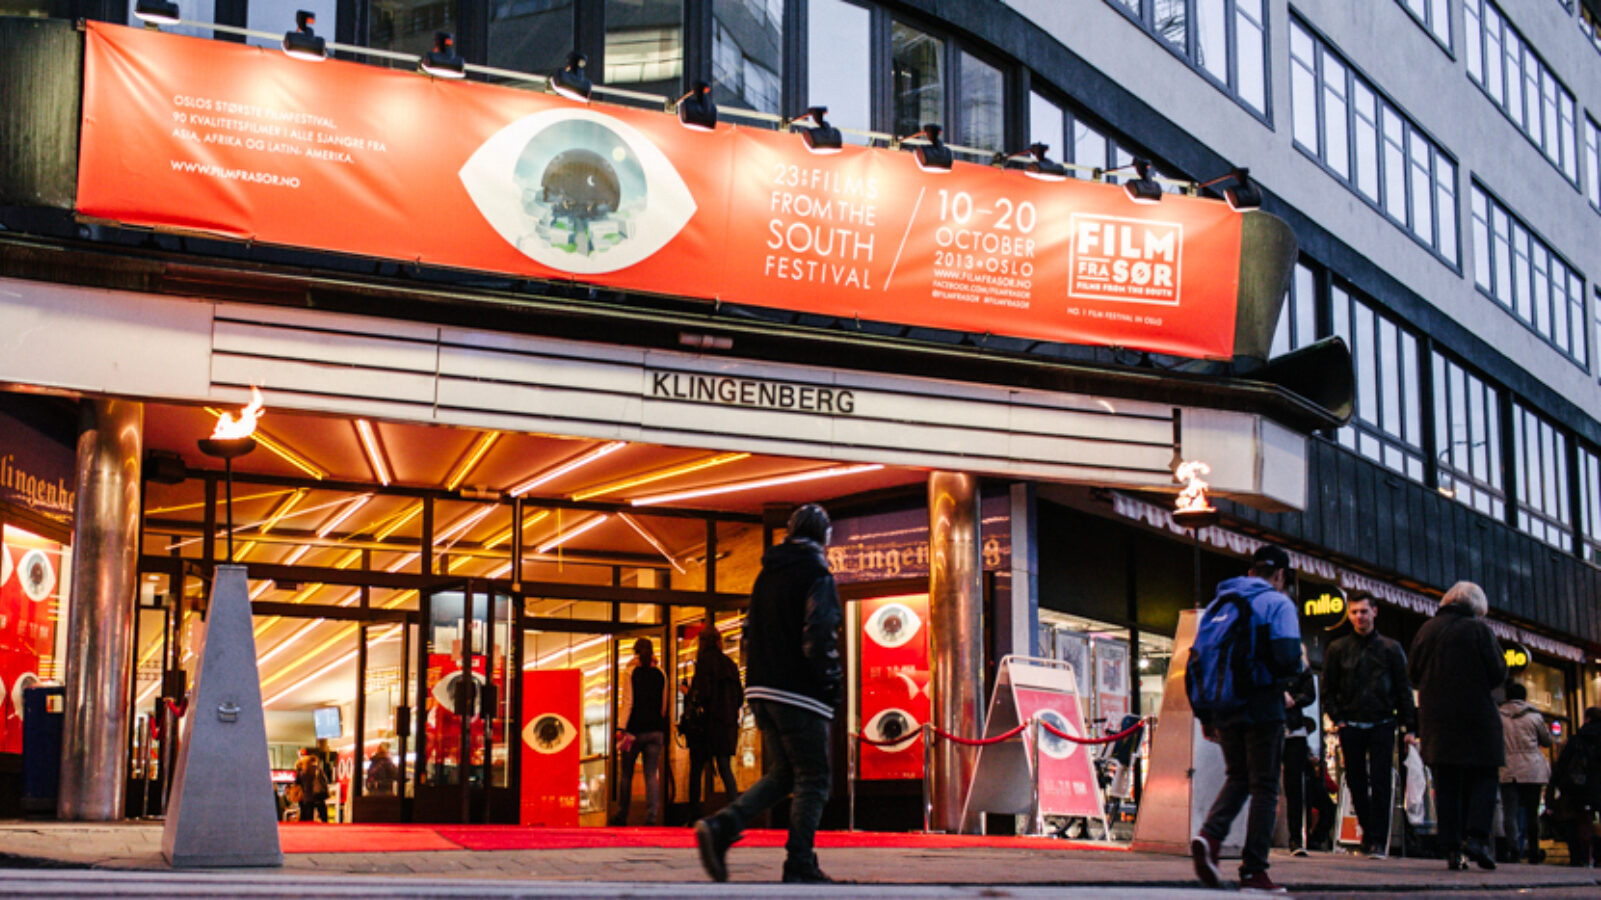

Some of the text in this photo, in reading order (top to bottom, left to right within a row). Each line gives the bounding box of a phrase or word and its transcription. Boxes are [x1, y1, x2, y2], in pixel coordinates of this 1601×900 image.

[173, 95, 213, 110] OSLOS
[172, 111, 188, 123] 90
[291, 129, 314, 142] ALLE
[317, 132, 364, 150] SJANGRE
[367, 140, 387, 152] FRA
[172, 128, 201, 143] ASIA,
[203, 133, 243, 148] AFRIKA
[245, 137, 265, 151] OG
[305, 148, 356, 165] AMERIKA.
[170, 159, 301, 188] WWW.FILMFRASOR.NO
[771, 190, 877, 227] FROM THE
[766, 218, 875, 262] SOUTH
[935, 226, 1036, 258] OCTOBER
[1077, 221, 1175, 262] FILM
[764, 255, 871, 290] FESTIVAL
[1078, 260, 1110, 276] FRA
[1112, 259, 1174, 288] SØR
[652, 371, 855, 414] KLINGENBERG
[1304, 593, 1344, 616] nille
